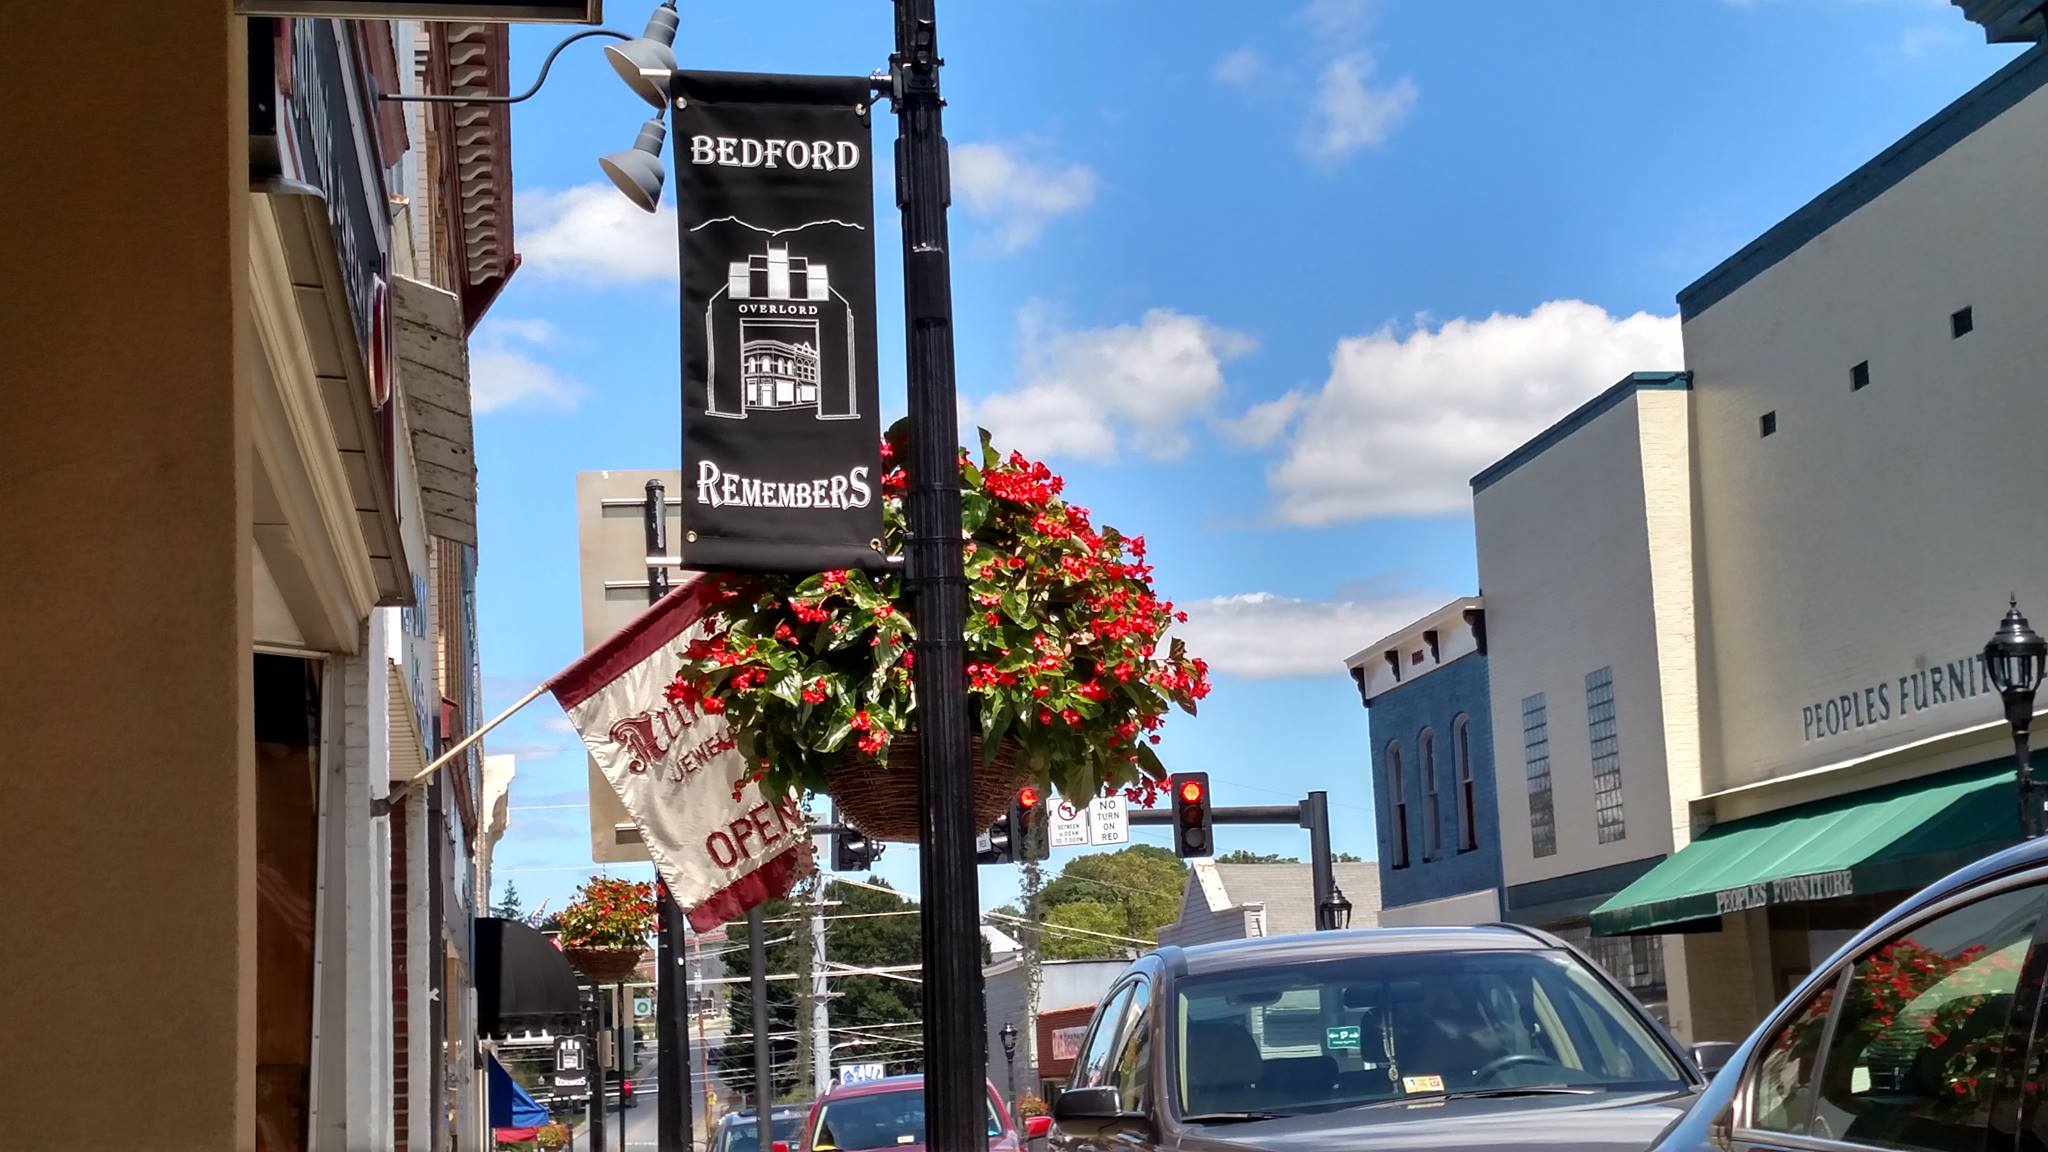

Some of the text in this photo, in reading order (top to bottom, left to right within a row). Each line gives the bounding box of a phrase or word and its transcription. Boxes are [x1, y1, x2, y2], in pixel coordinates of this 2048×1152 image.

[690, 135, 860, 171] BEDFORD
[738, 304, 818, 315] OVERLORD
[697, 460, 872, 510] REMEMBERS
[1803, 683, 1890, 741] PEOPLES
[1097, 812, 1119, 821] TURN
[1100, 800, 1116, 810] NO
[706, 794, 801, 869] OPEN
[1102, 833, 1118, 841] RED
[1103, 823, 1115, 831] ON
[1716, 870, 1854, 915] PEOPLES FURNITURE
